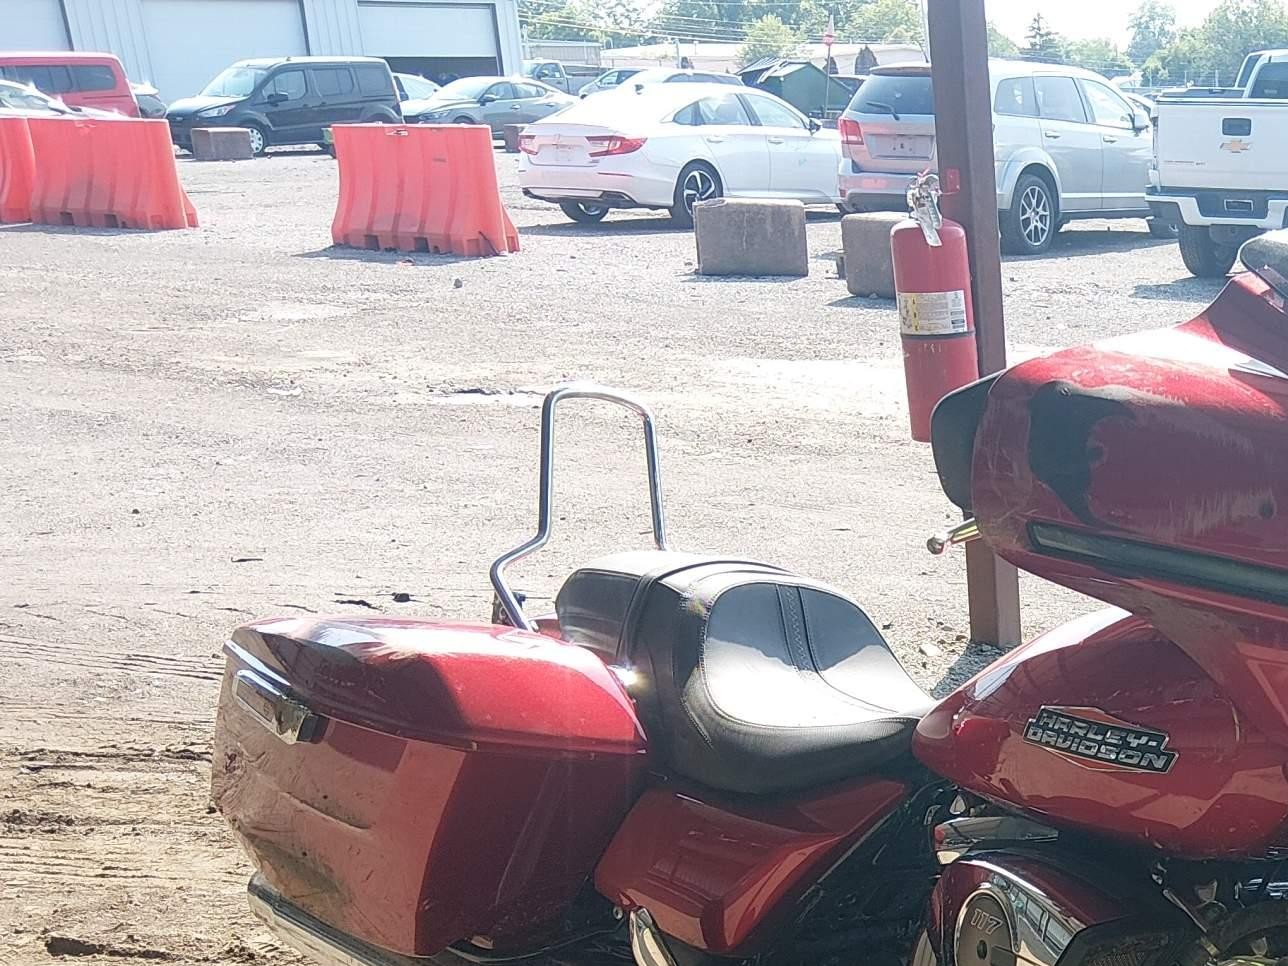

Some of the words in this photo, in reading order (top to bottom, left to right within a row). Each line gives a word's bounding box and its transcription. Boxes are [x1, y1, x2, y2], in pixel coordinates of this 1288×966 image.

[1026, 726, 1168, 769] DAVIDSON
[1038, 712, 1158, 748] HARLEY-
[970, 908, 1003, 935] 117
